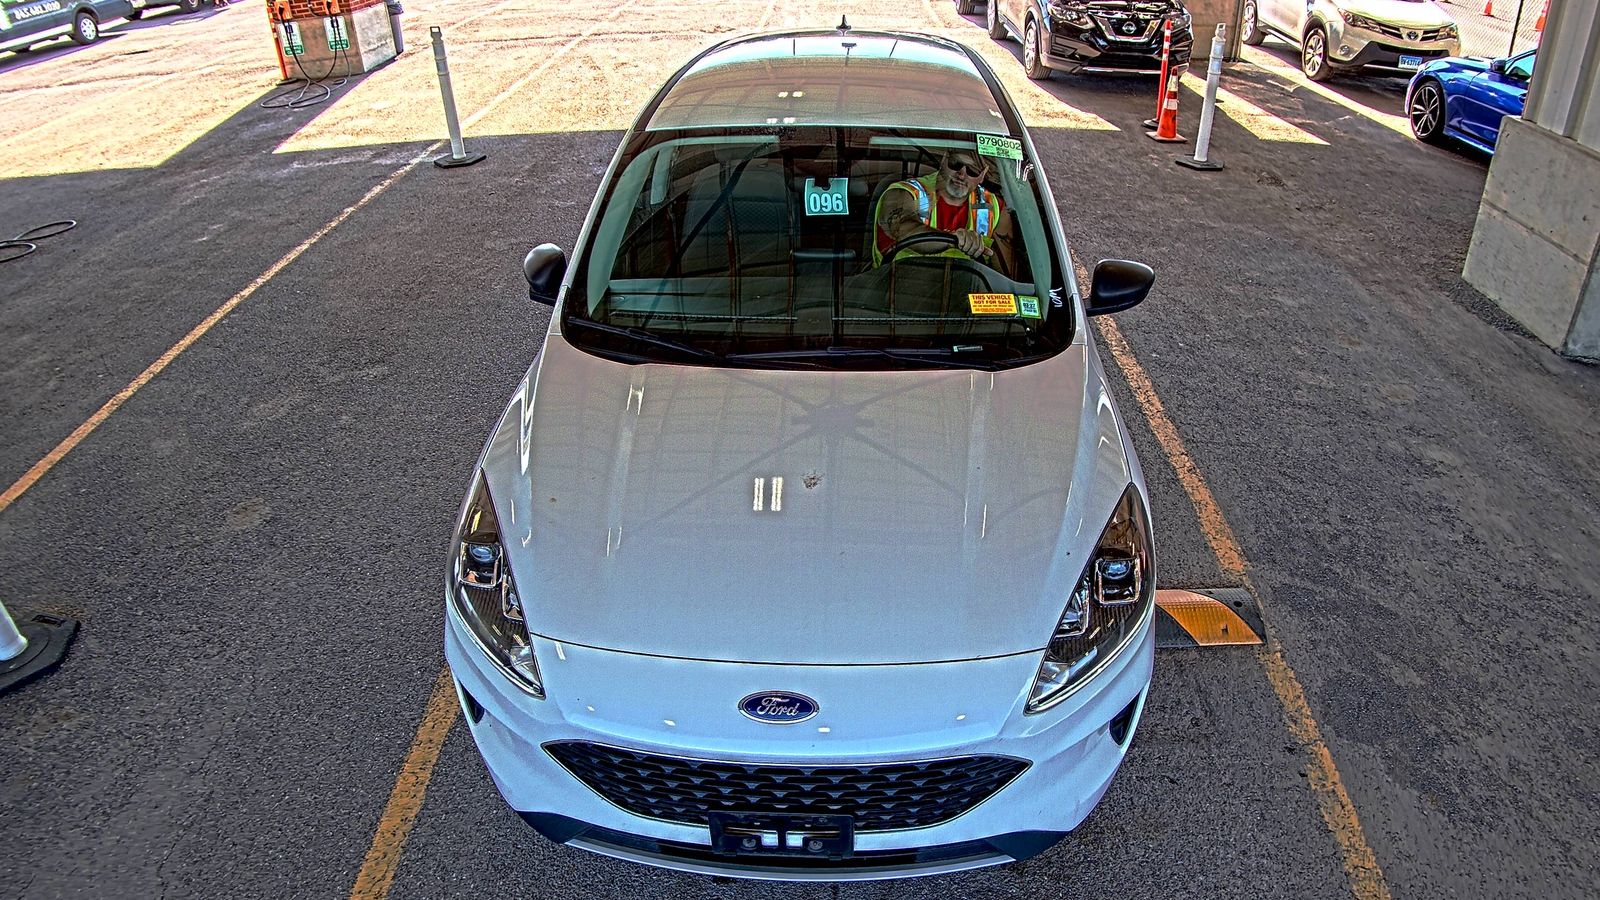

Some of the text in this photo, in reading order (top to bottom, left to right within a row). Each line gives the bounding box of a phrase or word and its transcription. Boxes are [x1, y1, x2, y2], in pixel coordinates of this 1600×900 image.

[979, 136, 1021, 150] 9790802
[810, 193, 843, 212] 096
[757, 697, 800, 715] Ford
